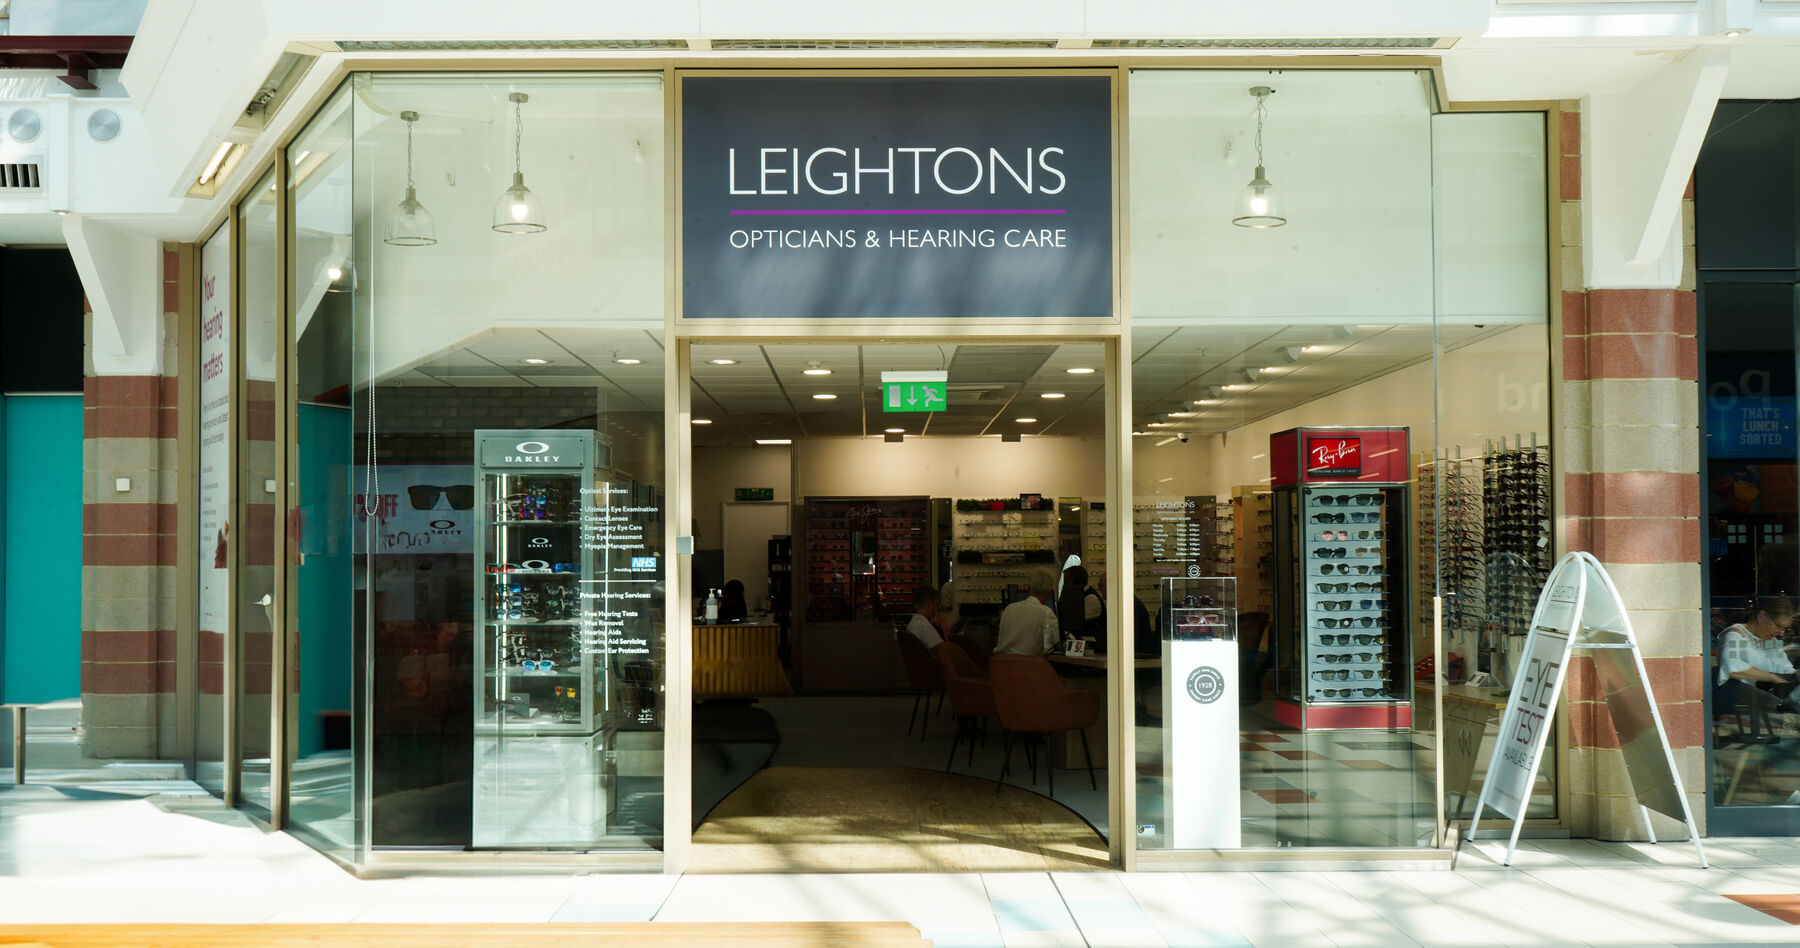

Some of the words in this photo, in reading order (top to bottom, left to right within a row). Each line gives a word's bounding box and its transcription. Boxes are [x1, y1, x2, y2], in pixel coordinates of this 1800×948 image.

[729, 147, 1066, 195] LEIGHTONS
[730, 229, 856, 248] OPTICIANS
[865, 230, 880, 248] &
[890, 229, 994, 248] HEARING
[1004, 229, 1066, 248] CARE
[203, 274, 216, 303] Your
[203, 306, 223, 344] hearing
[203, 352, 223, 383] matters
[1742, 408, 1780, 419] THAT'S
[1743, 420, 1778, 432] LUNCH
[1312, 440, 1356, 464] Ray-Ban
[1740, 434, 1782, 445] SORTED
[632, 558, 655, 567] NHS
[1520, 658, 1560, 709] EYE
[1512, 707, 1544, 747] TEST
